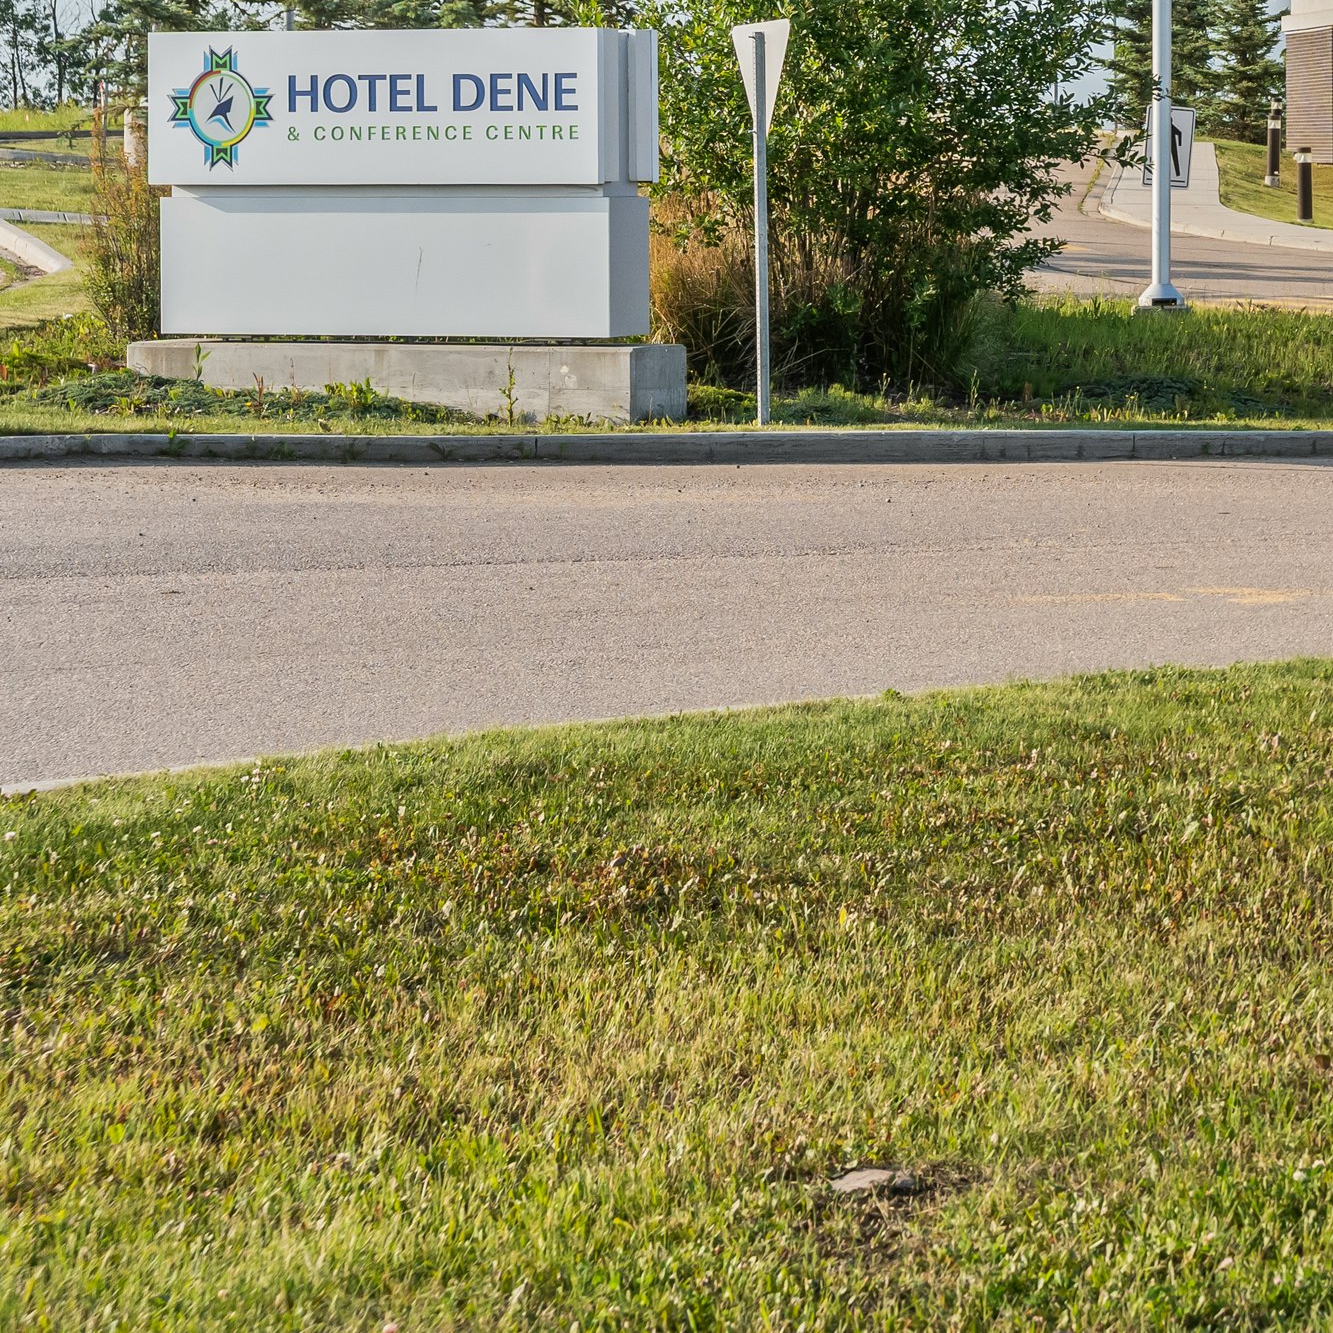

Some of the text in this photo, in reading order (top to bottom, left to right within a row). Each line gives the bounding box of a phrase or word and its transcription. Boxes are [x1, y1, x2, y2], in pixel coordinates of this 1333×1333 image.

[287, 72, 580, 113] HOTEL DENE
[286, 124, 580, 141] & CONFERENCE CENTRE
